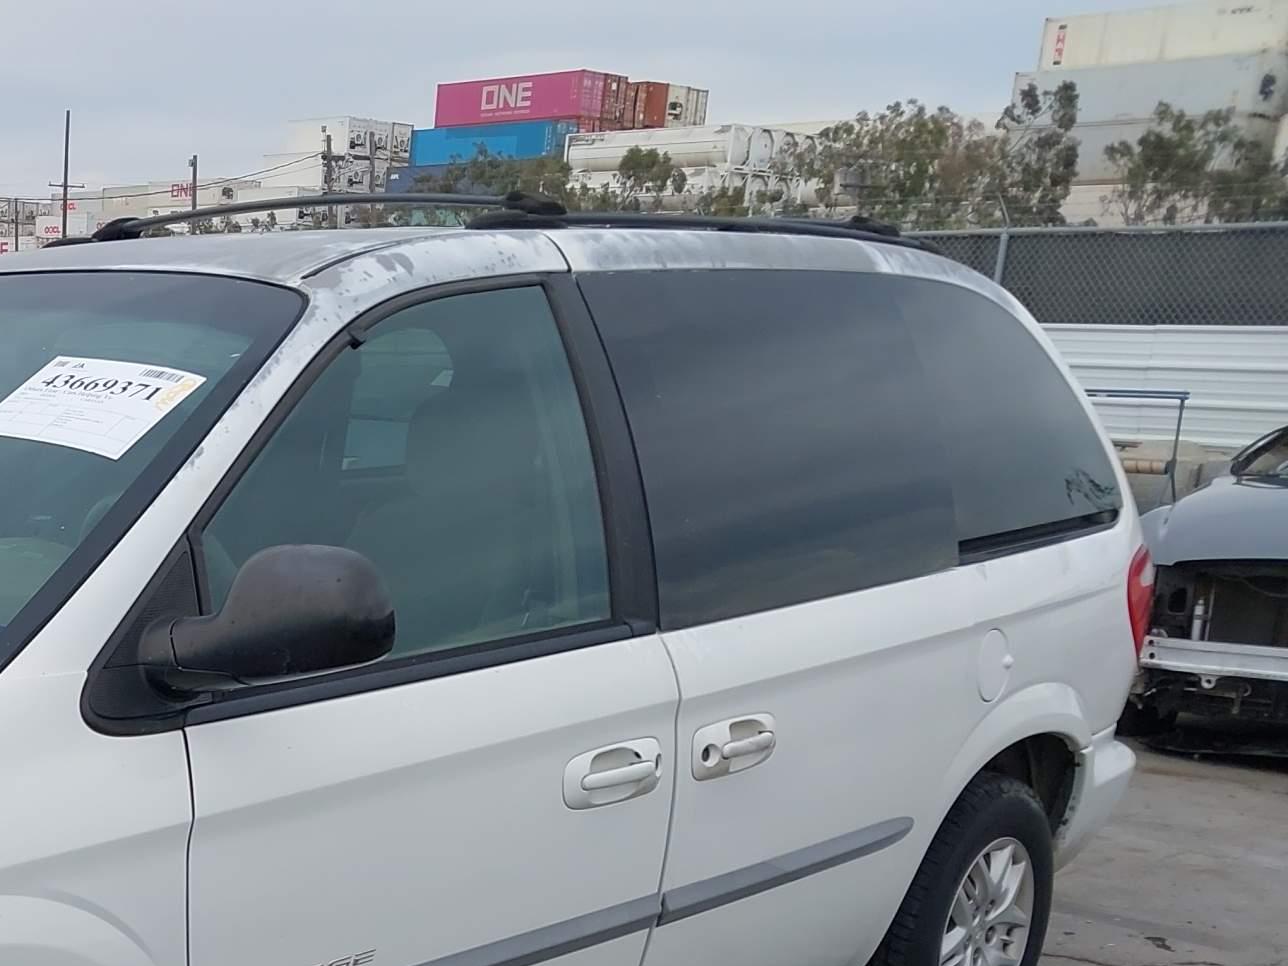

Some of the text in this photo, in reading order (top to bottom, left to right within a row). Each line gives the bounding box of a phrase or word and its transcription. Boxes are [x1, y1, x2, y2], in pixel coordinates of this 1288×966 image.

[481, 81, 533, 111] ONE
[44, 225, 61, 234] OOCL
[41, 373, 163, 402] 43669371
